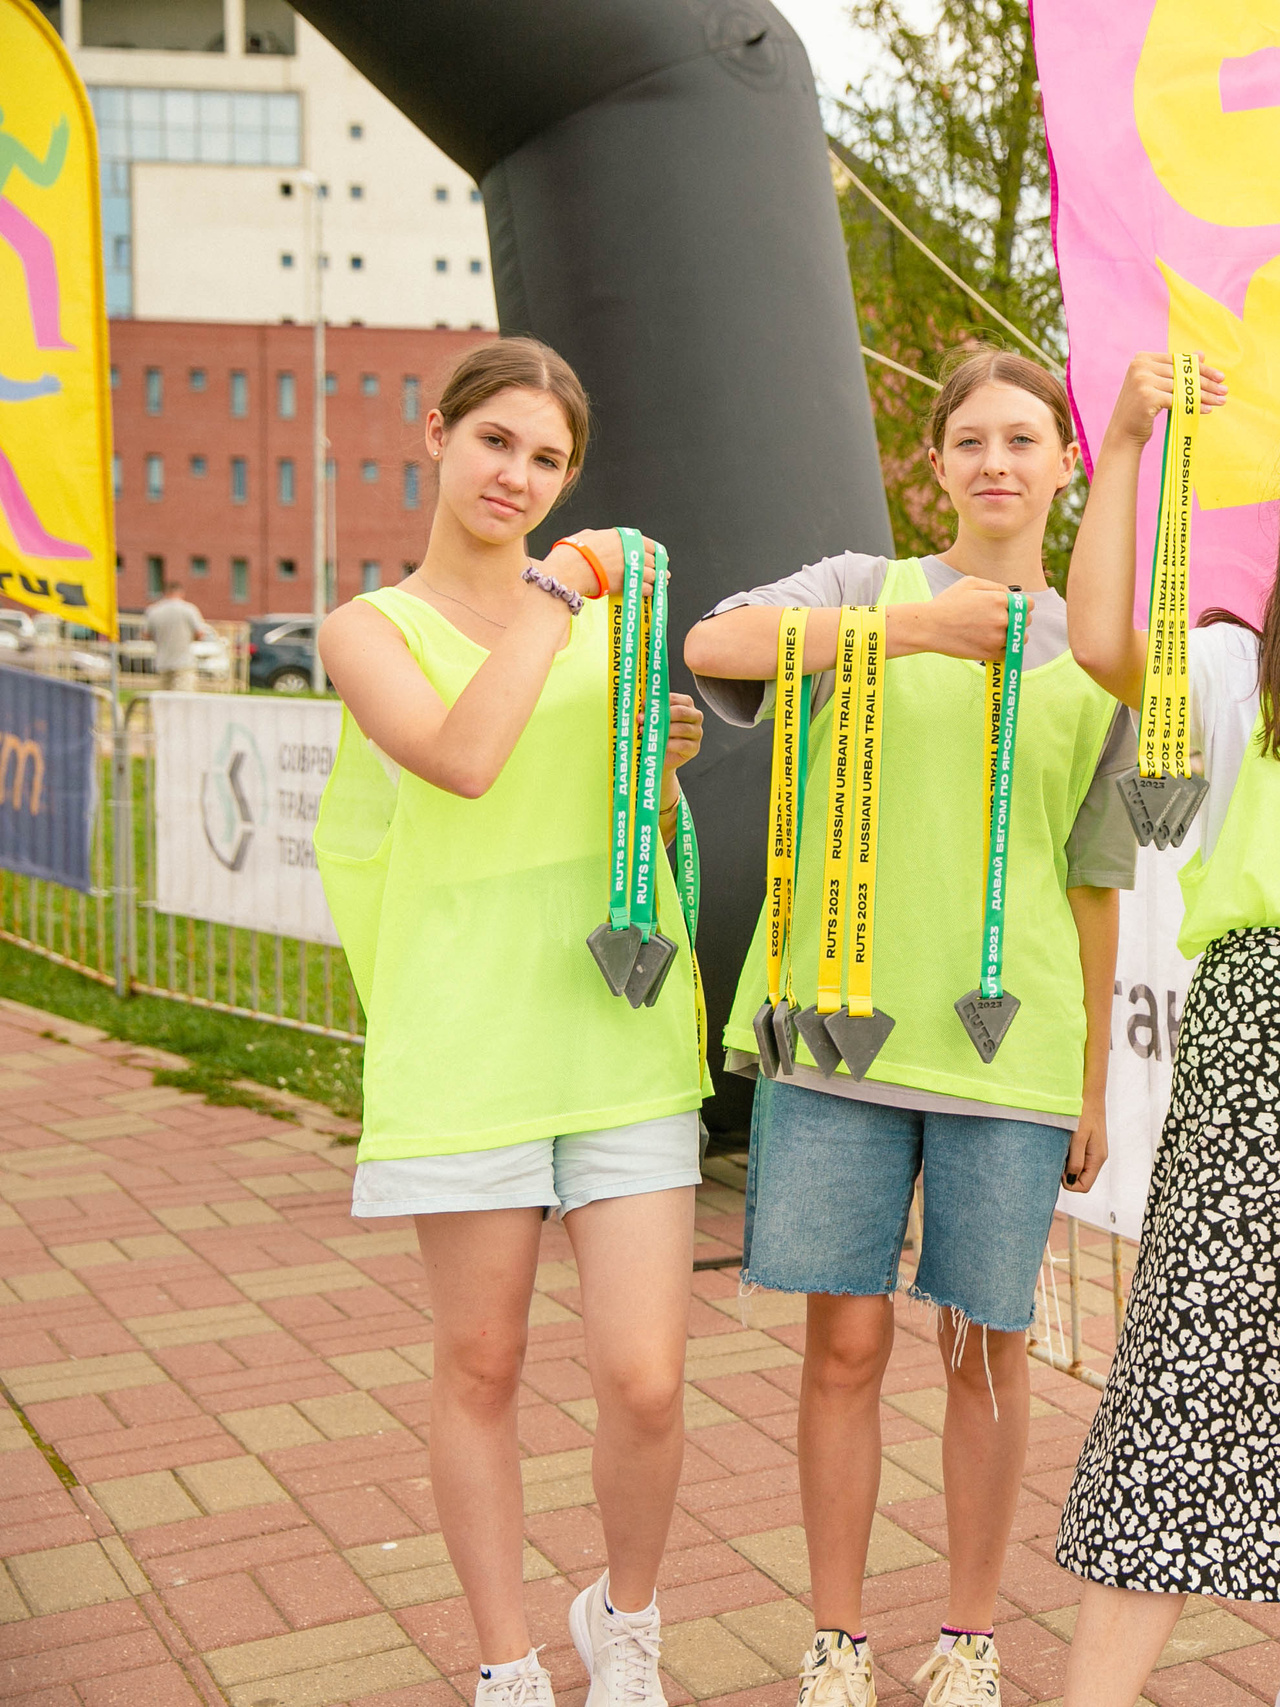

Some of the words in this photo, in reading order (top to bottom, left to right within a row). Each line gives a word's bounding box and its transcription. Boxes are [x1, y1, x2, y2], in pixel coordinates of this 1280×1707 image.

[1185, 378, 1194, 415] 2023
[1182, 436, 1192, 506] RUSSIAN
[1180, 511, 1188, 566] URBAN
[625, 550, 639, 654] ЯРОСЛАВЛЮ
[1157, 572, 1167, 616] TRAIL
[1179, 571, 1187, 616] TRAIL
[613, 605, 622, 671] RUSSIAN
[652, 570, 664, 670] ЯРОСЛАВЛЮ
[1011, 612, 1023, 653] RUTS
[624, 657, 634, 677] ПО
[785, 627, 797, 681] SERIES
[842, 628, 855, 682] SERIES
[867, 631, 878, 686] SERIES
[1152, 618, 1165, 675] SERIES
[1166, 621, 1175, 676] SERIES
[1179, 620, 1187, 675] SERIES
[651, 673, 661, 695] ПО
[620, 683, 633, 738] БЕГОМ
[647, 699, 660, 753] БЕГОМ
[784, 685, 794, 728] TRAIL
[839, 687, 852, 730] TRAIL
[865, 690, 876, 734] TRAIL
[991, 692, 1001, 744] URBAN
[1002, 669, 1018, 771] ЯРОСЛАВЛЮ
[1147, 696, 1158, 738] RUTS
[1163, 697, 1173, 738] RUTS
[1177, 697, 1187, 738] RUTS
[617, 740, 630, 796] ДАВАЙ
[784, 733, 793, 786] URBAN
[836, 734, 848, 788] URBAN
[863, 738, 874, 792] URBAN
[1160, 742, 1171, 770] 202
[643, 756, 657, 810] ДАВАЙ
[1000, 774, 1010, 796] ПО
[617, 811, 627, 848] 2023
[639, 825, 652, 862] 2023
[832, 792, 845, 859] RUSSIAN
[859, 796, 871, 863] RUSSIAN
[996, 799, 1008, 852] БЕГОМ
[615, 850, 625, 891] RUTS
[683, 834, 694, 882] БЕГОМ
[637, 864, 650, 904] RUTS
[686, 886, 695, 906] ПО
[772, 877, 782, 916] RUTS
[828, 879, 840, 916] 2023
[856, 883, 868, 920] 2023
[992, 857, 1003, 910] ДАВАЙ
[771, 921, 779, 957] 2023
[826, 919, 838, 959] RUTS
[855, 923, 866, 963] RUTS
[988, 925, 999, 962] 2023
[977, 1001, 1003, 1010] 2023
